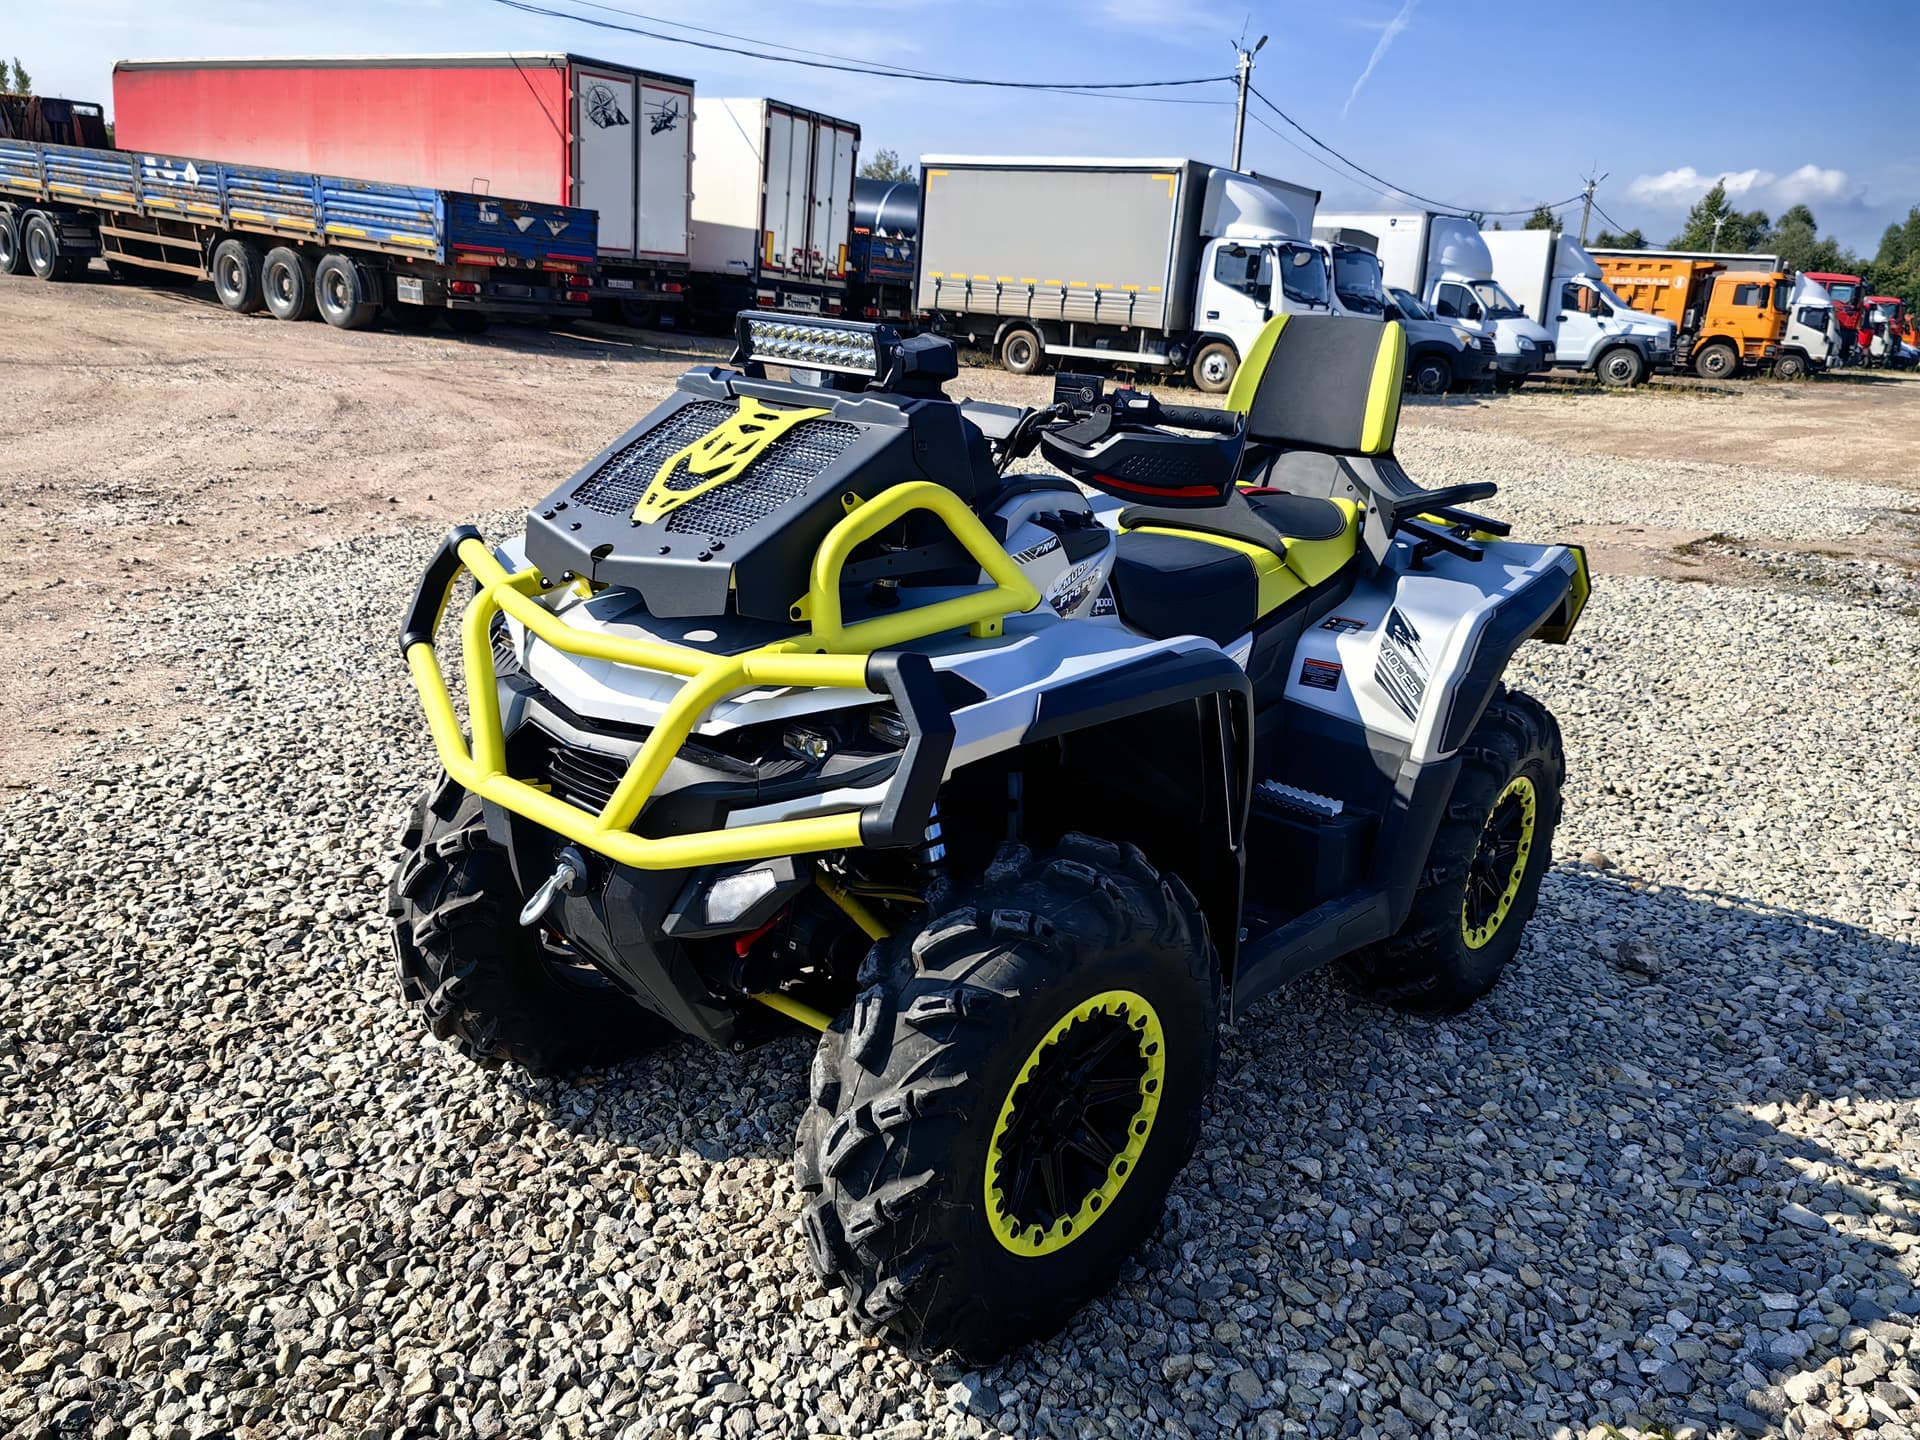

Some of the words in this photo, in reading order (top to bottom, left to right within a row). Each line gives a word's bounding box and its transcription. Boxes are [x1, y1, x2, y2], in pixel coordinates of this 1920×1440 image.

[1608, 276, 1670, 286] SHACMAN
[1035, 538, 1057, 555] PRO
[1381, 647, 1421, 698] AODES
